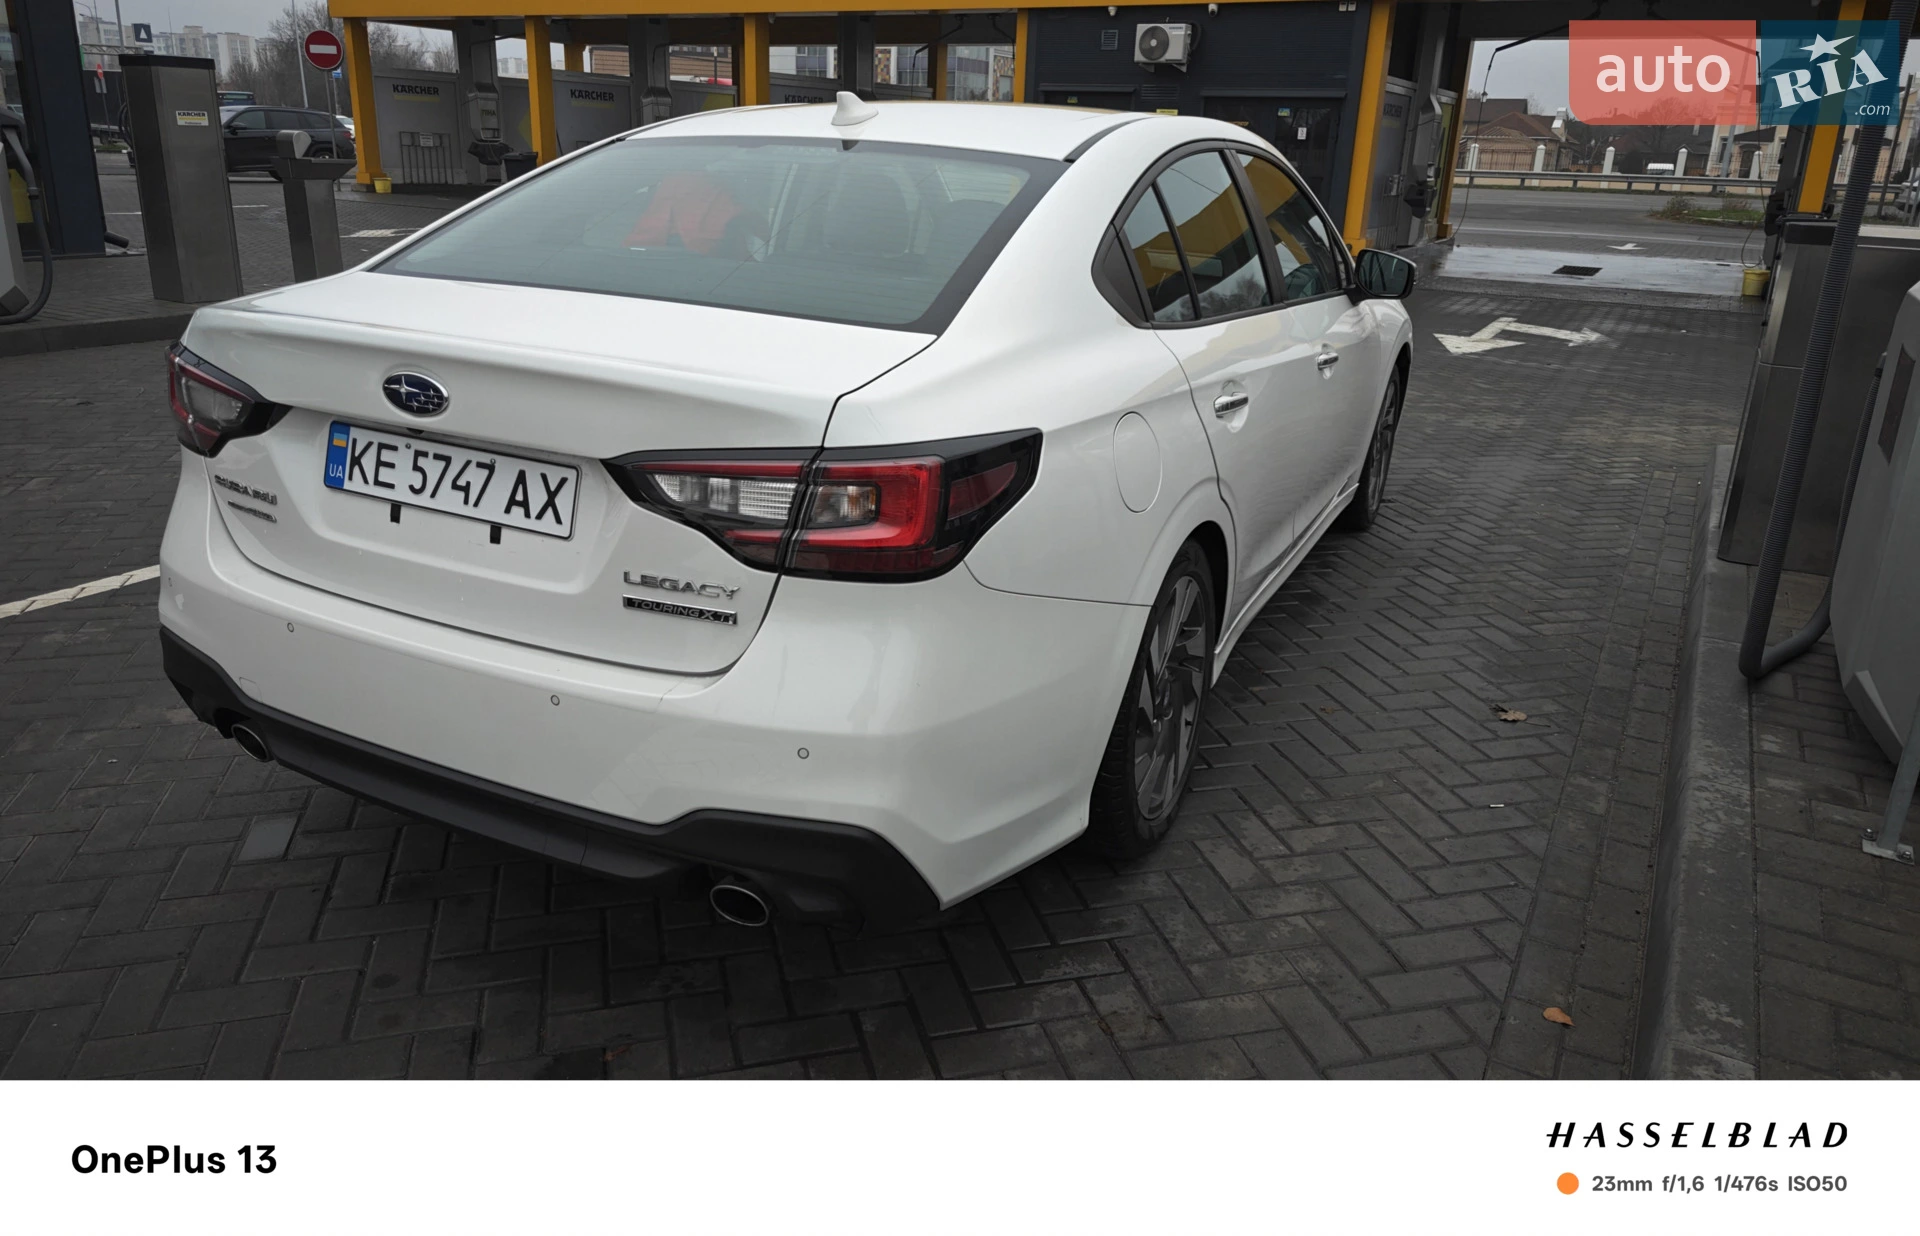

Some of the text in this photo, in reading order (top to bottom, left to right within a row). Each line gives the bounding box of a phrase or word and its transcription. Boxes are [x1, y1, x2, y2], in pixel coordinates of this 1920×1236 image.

[392, 83, 440, 96] KÄRCHER
[570, 88, 615, 102] KÄRCHER
[329, 464, 344, 479] UA
[348, 437, 569, 525] KE 5747 AX
[623, 570, 741, 600] LEGACY
[632, 599, 701, 618] TOURING
